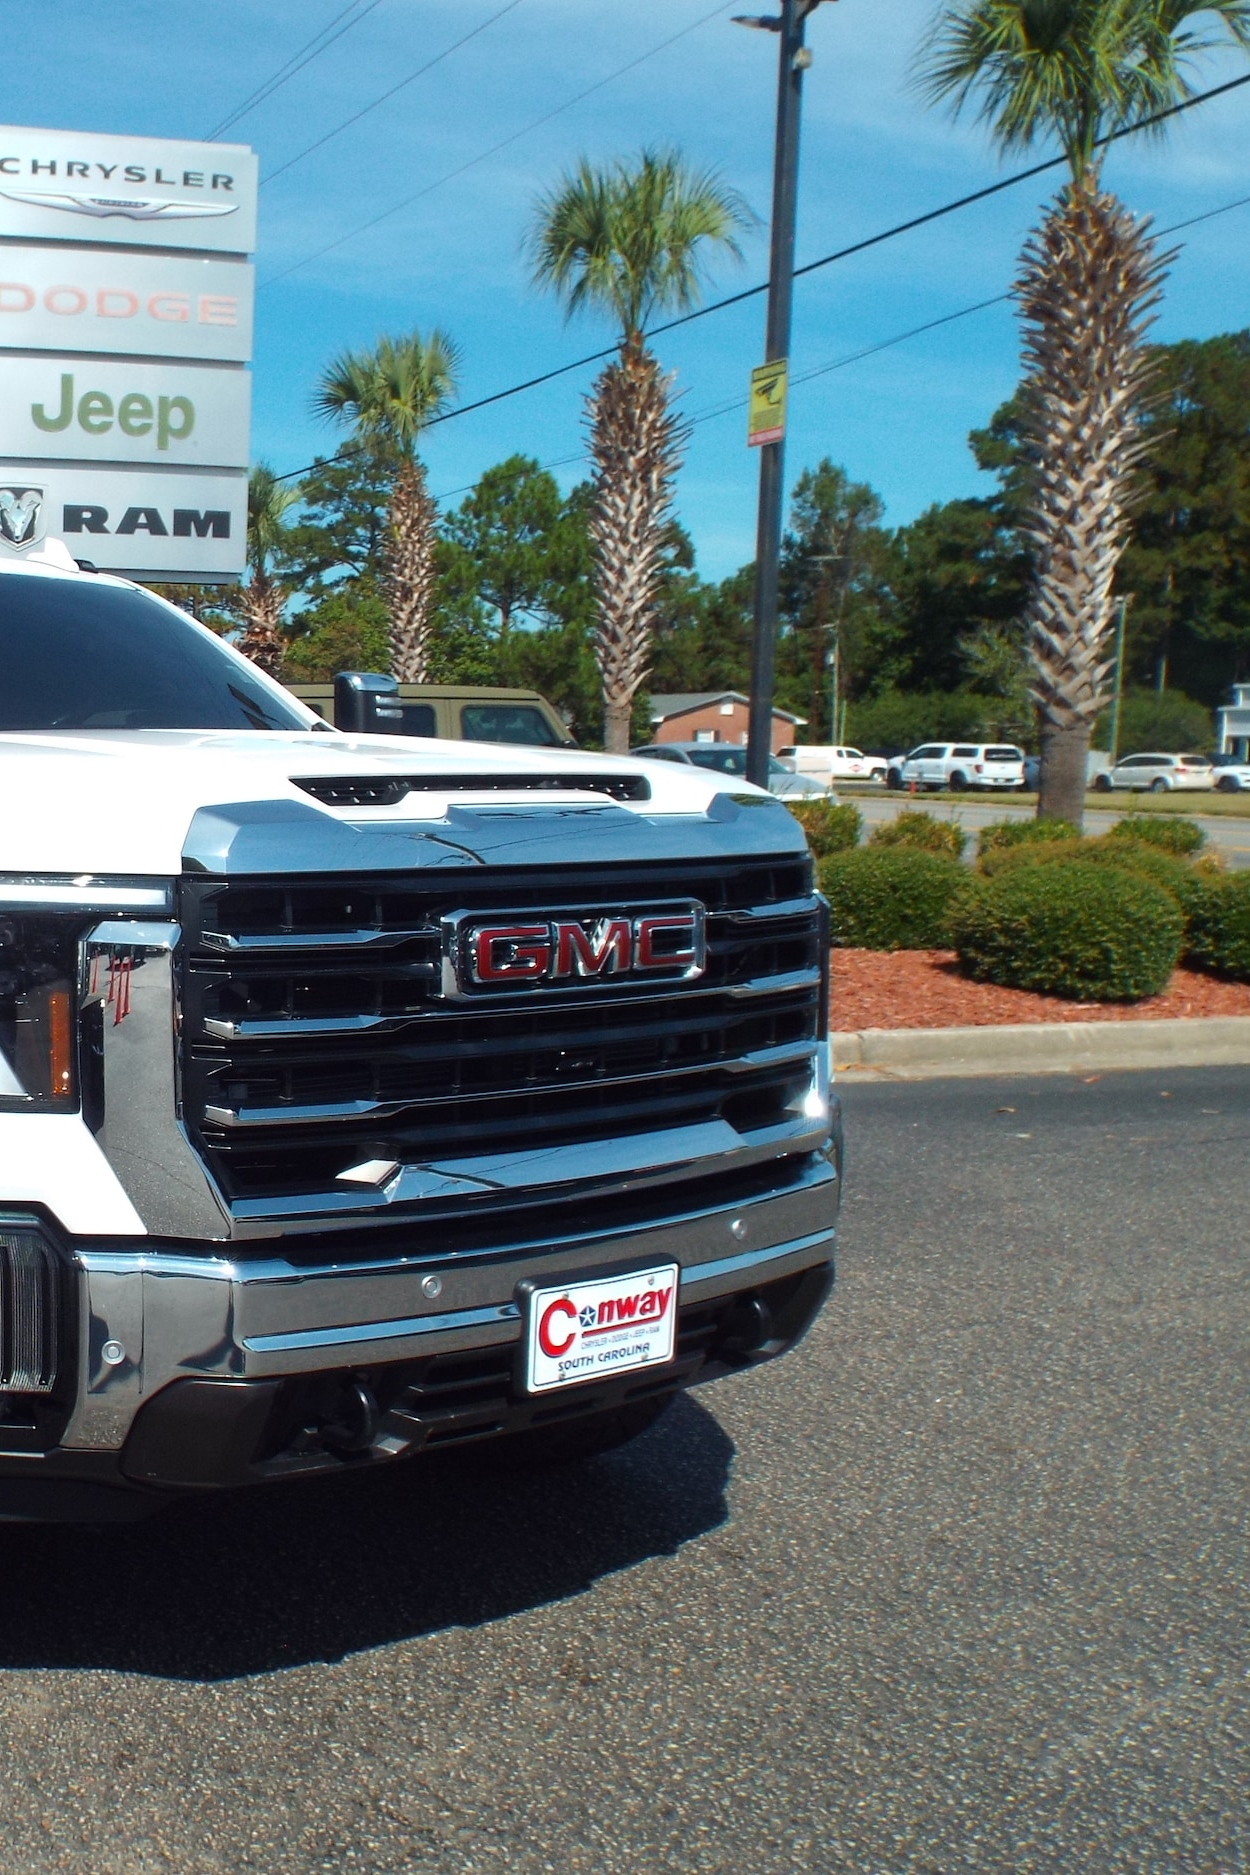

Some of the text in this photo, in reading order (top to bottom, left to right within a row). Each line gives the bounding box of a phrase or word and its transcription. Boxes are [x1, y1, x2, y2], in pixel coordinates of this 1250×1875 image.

[31, 373, 195, 450] Jeep
[63, 504, 230, 539] RAM
[475, 915, 696, 983] GMC
[558, 1342, 650, 1372] SOUTH CAROLINA
[581, 1336, 608, 1350] CHRYSLER
